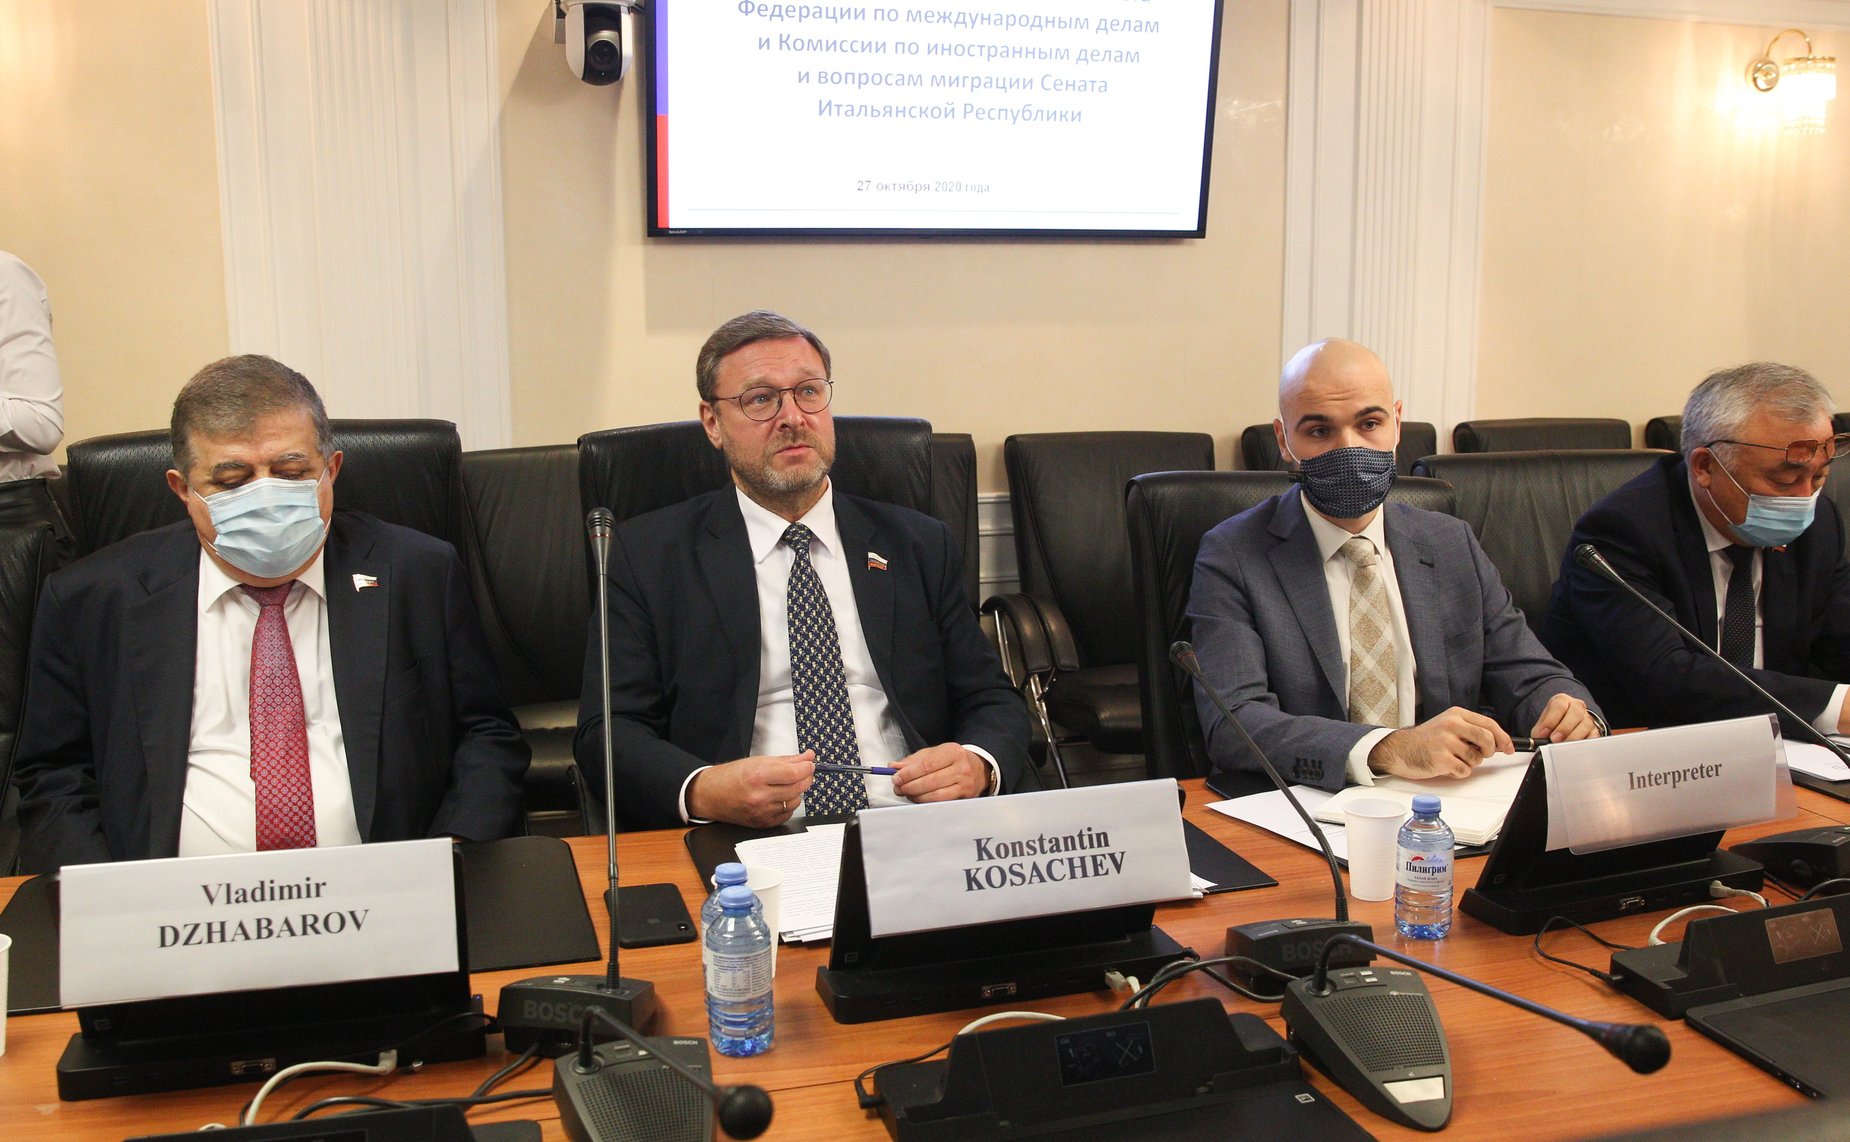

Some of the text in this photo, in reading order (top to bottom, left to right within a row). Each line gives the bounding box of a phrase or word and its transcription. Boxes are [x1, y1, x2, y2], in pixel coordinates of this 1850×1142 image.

[738, 0, 1160, 35] Федерации по международным делам
[758, 33, 1140, 65] и Комиссии по иностранным делам
[797, 71, 1108, 93] и вопросам миграции Сената
[818, 99, 1082, 125] Итальянской Республики
[856, 180, 991, 195] 27 октября 2020 года
[1628, 762, 1723, 791] Interpreter
[974, 826, 1110, 862] Konstantin
[963, 851, 1127, 892] KOSACHEV
[1406, 861, 1447, 876] Пилигрим
[201, 877, 327, 906] Vladimir
[158, 909, 370, 949] DZHABAROV
[523, 999, 600, 1025] BOSC
